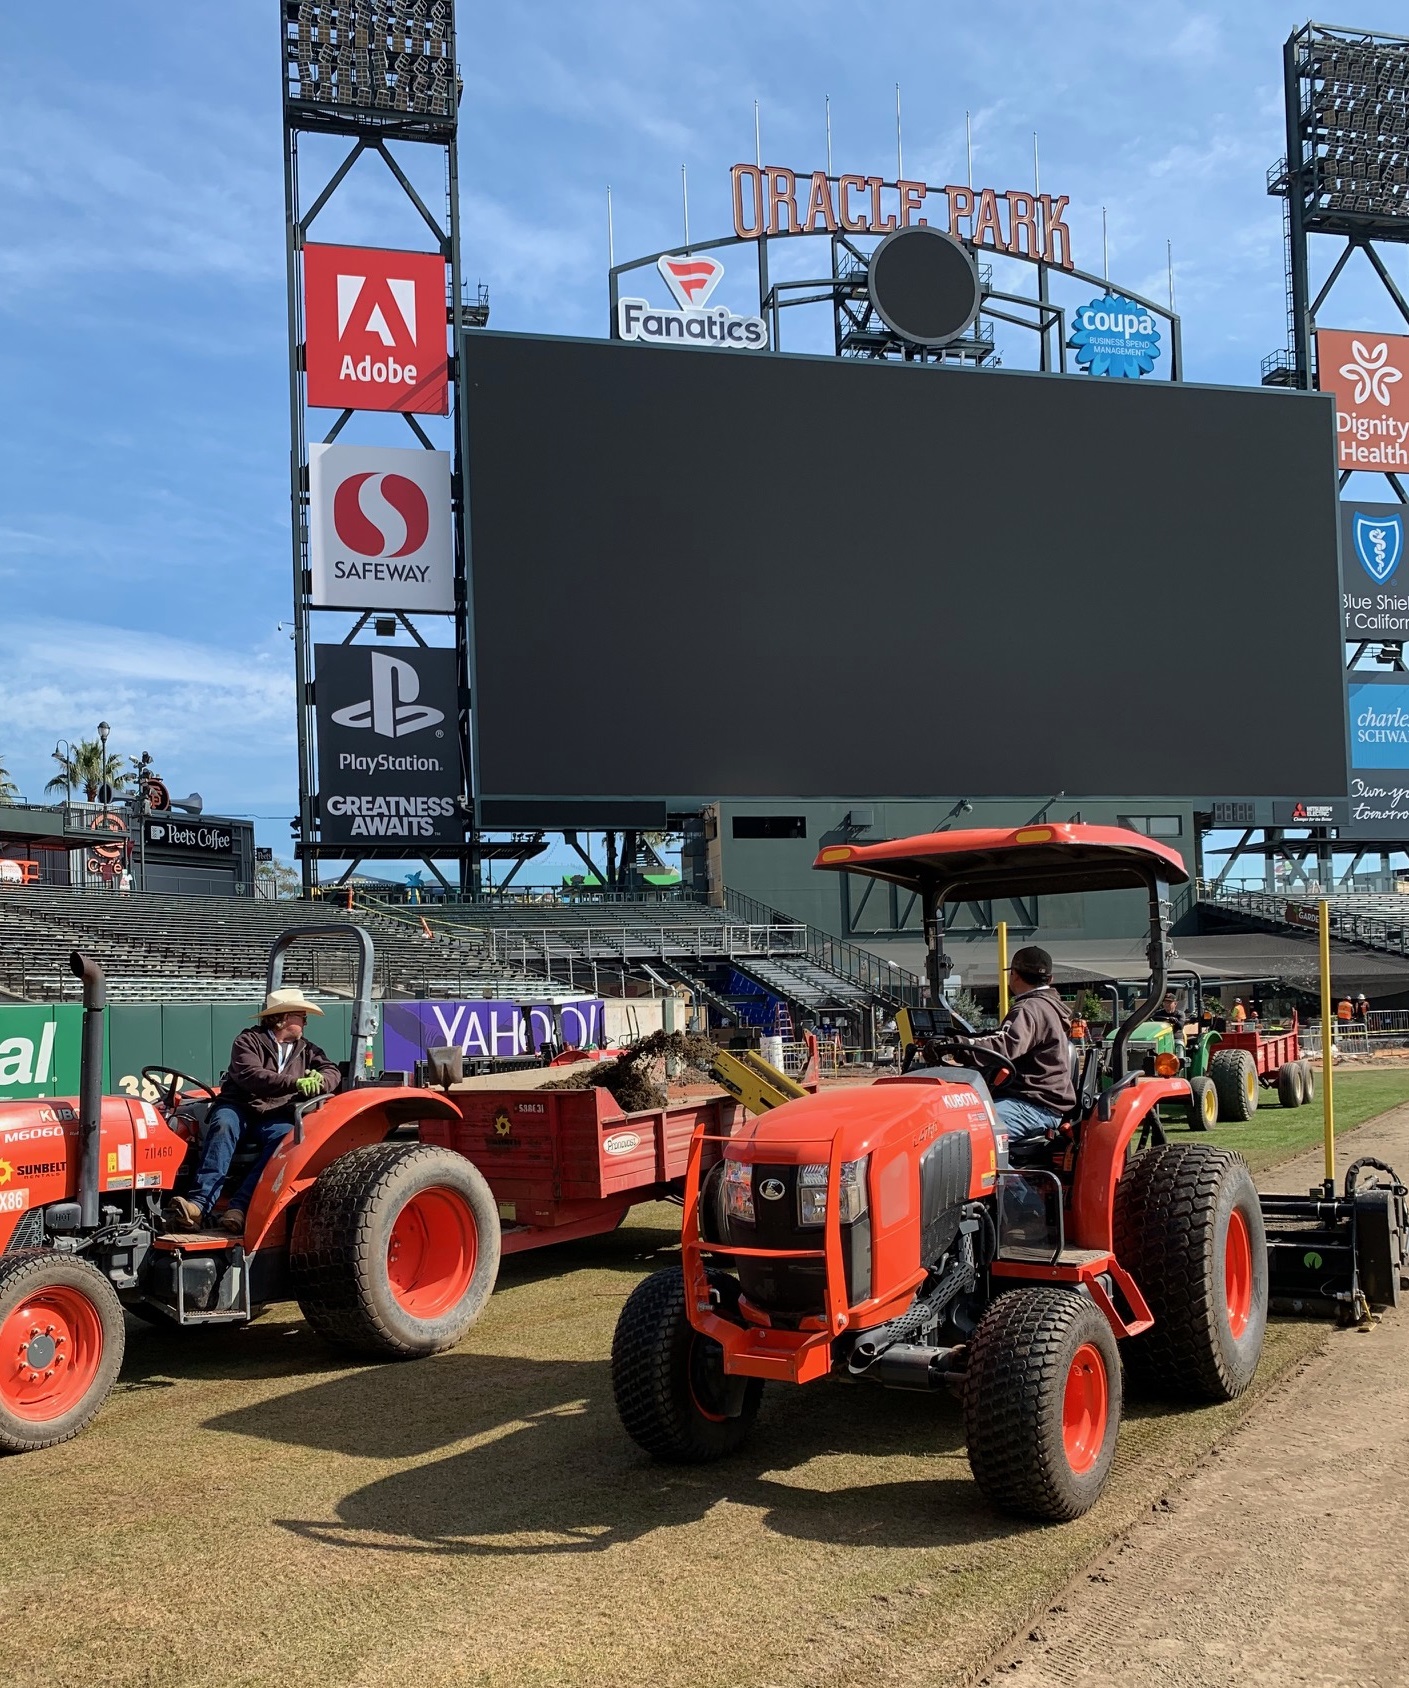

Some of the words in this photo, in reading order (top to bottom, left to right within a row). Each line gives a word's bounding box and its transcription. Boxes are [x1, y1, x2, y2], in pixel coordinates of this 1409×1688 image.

[730, 163, 928, 239] ORACLE
[943, 184, 1075, 272] PARK
[624, 304, 762, 343] Fanatics
[1082, 311, 1153, 340] coupa
[1089, 336, 1125, 347] BUSINESS
[1125, 339, 1150, 349] SPEND
[1093, 345, 1146, 357] MANAGEMENT
[339, 354, 418, 385] Adobe
[1336, 411, 1409, 443] Dignity
[1340, 440, 1408, 465] Health
[334, 560, 431, 583] SAFEWAY
[1357, 729, 1409, 743] SCHWA
[339, 753, 440, 775] PlayStation
[326, 795, 455, 817] GREATNESS
[166, 823, 196, 846] Peet's
[197, 828, 231, 851] Coffee
[350, 817, 434, 837] AWAITS
[432, 1003, 597, 1056] YAHOO!
[941, 1092, 979, 1109] KUBOTA
[144, 1146, 173, 1159] 711460
[17, 1161, 67, 1176] SUNBELT
[55, 1212, 71, 1222] HOT
